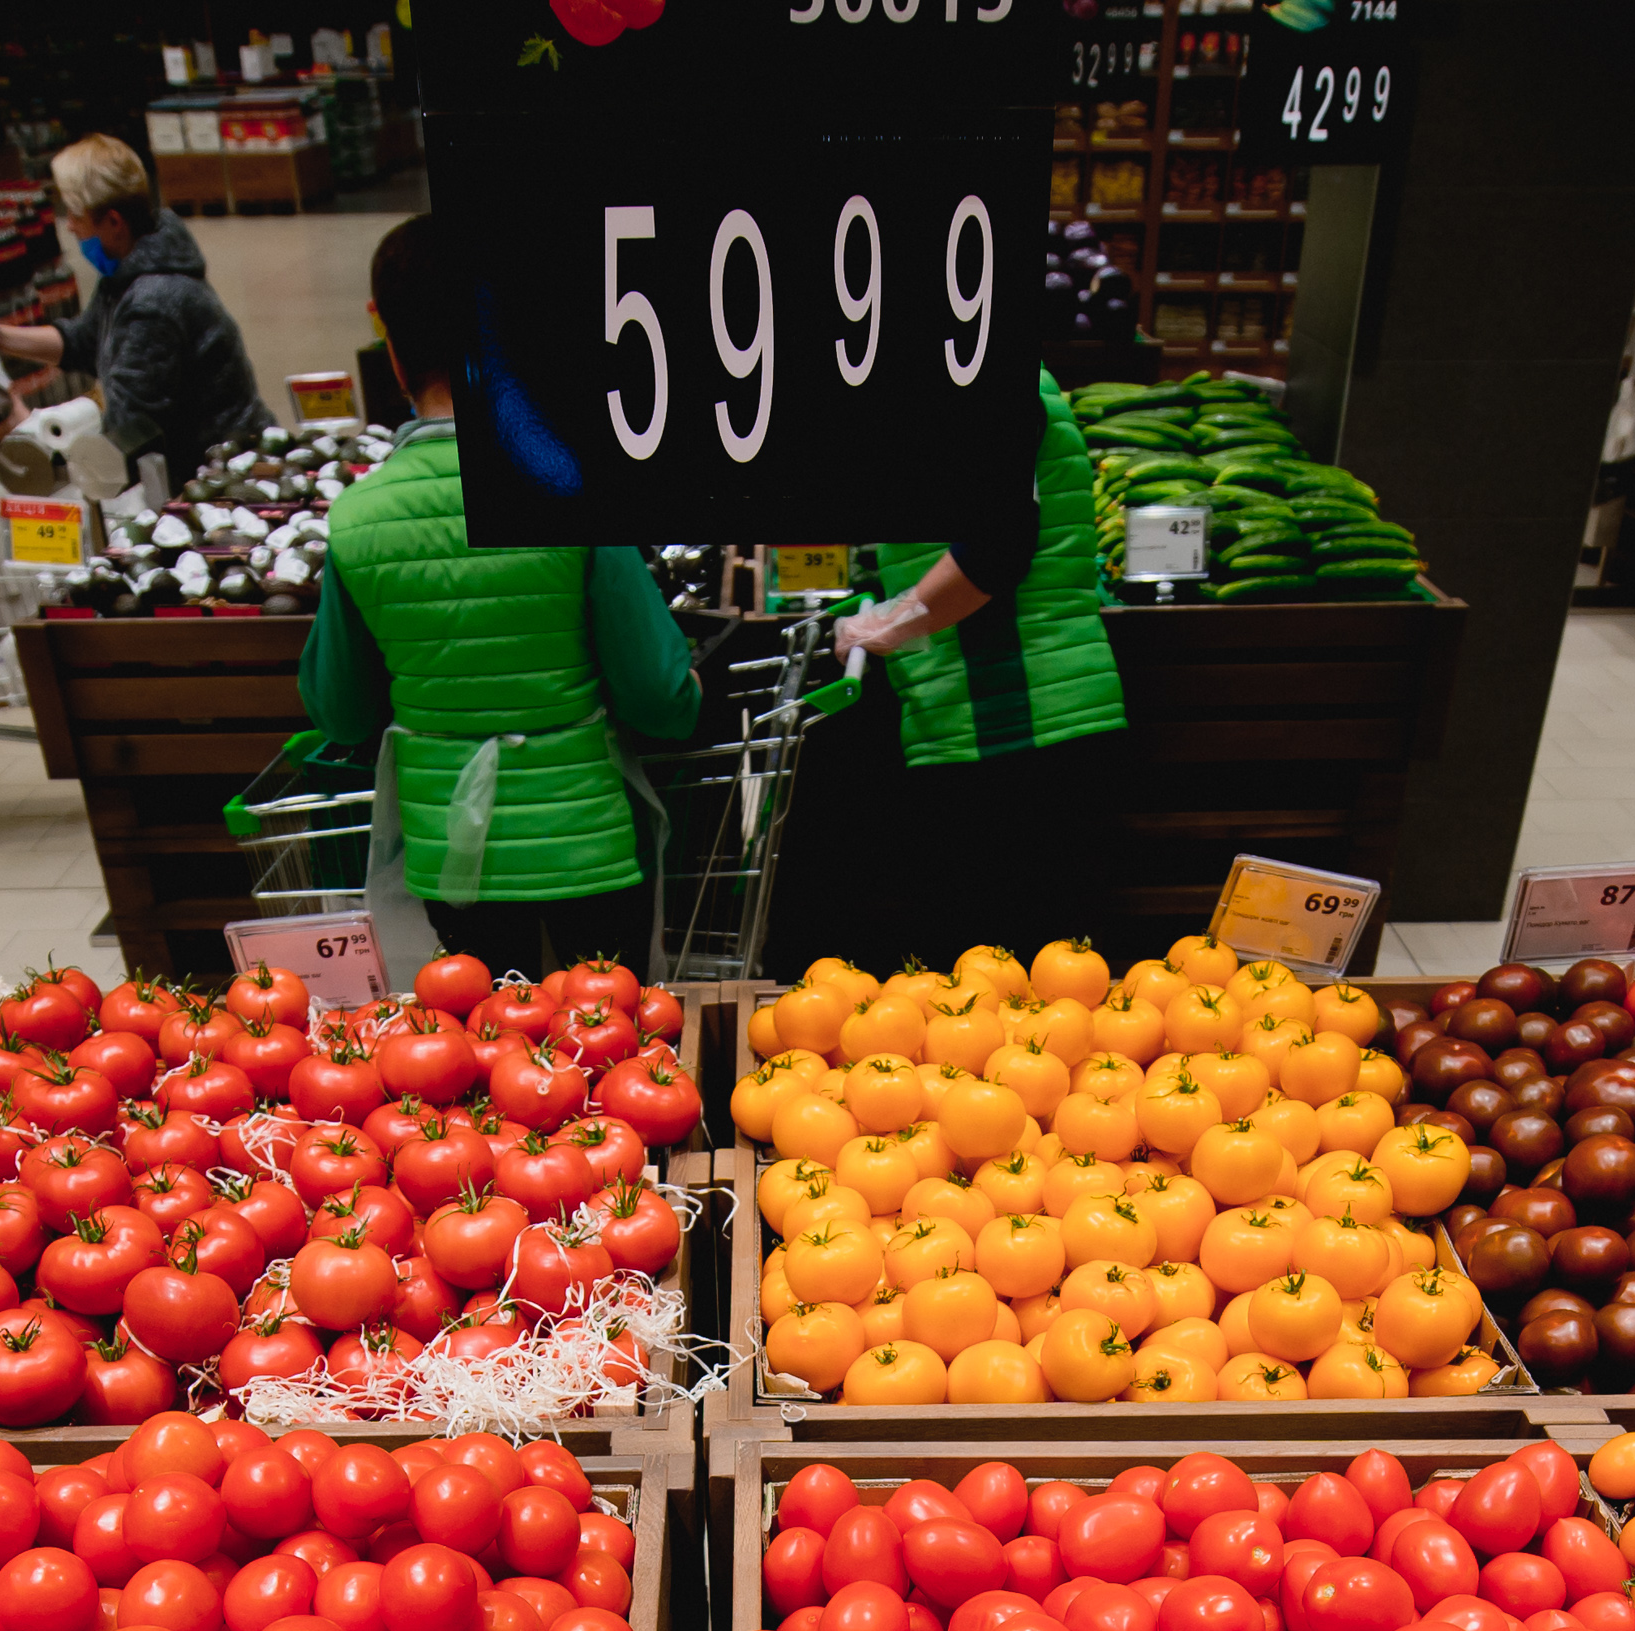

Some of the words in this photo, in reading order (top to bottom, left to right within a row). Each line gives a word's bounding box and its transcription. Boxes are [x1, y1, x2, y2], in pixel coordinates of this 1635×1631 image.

[1351, 0, 1397, 21] 7144
[1304, 892, 1340, 914] 69
[316, 936, 348, 958] 67
